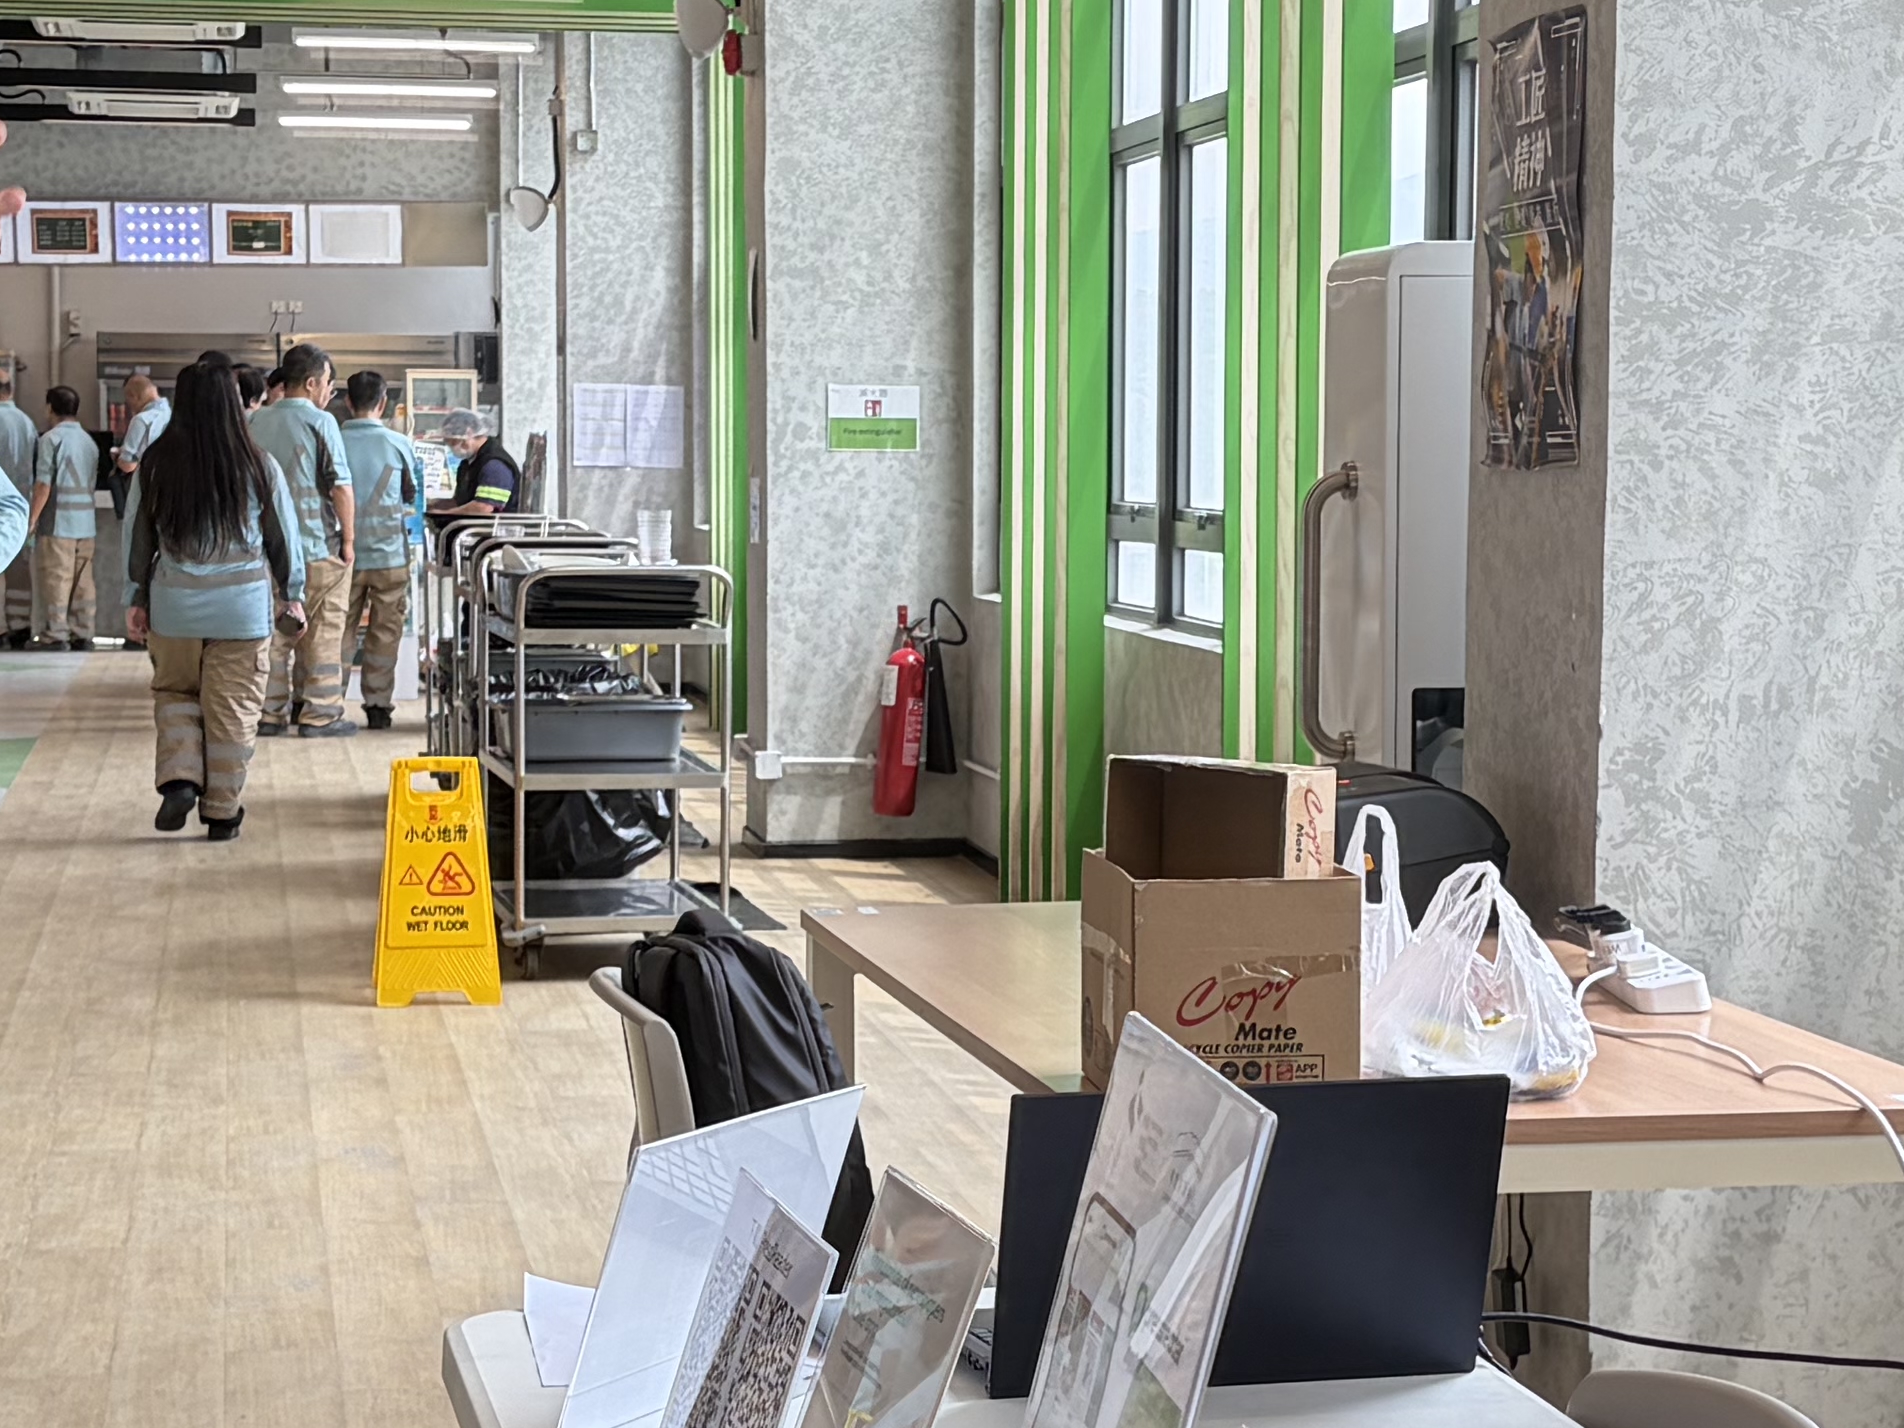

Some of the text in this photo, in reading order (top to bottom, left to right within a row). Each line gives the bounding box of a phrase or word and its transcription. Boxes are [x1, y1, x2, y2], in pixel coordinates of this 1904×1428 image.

[1515, 69, 1546, 128] 工匠
[1512, 131, 1547, 192] 精神
[404, 824, 469, 843] 小心地滑
[410, 904, 465, 917] CAUTION
[406, 920, 470, 932] WET FLOOR
[1176, 975, 1303, 1028] Copy
[1234, 1022, 1297, 1041] Mate
[1224, 1042, 1265, 1055] COPIER
[1267, 1042, 1304, 1054] PAPER
[1295, 1063, 1318, 1074] APP
